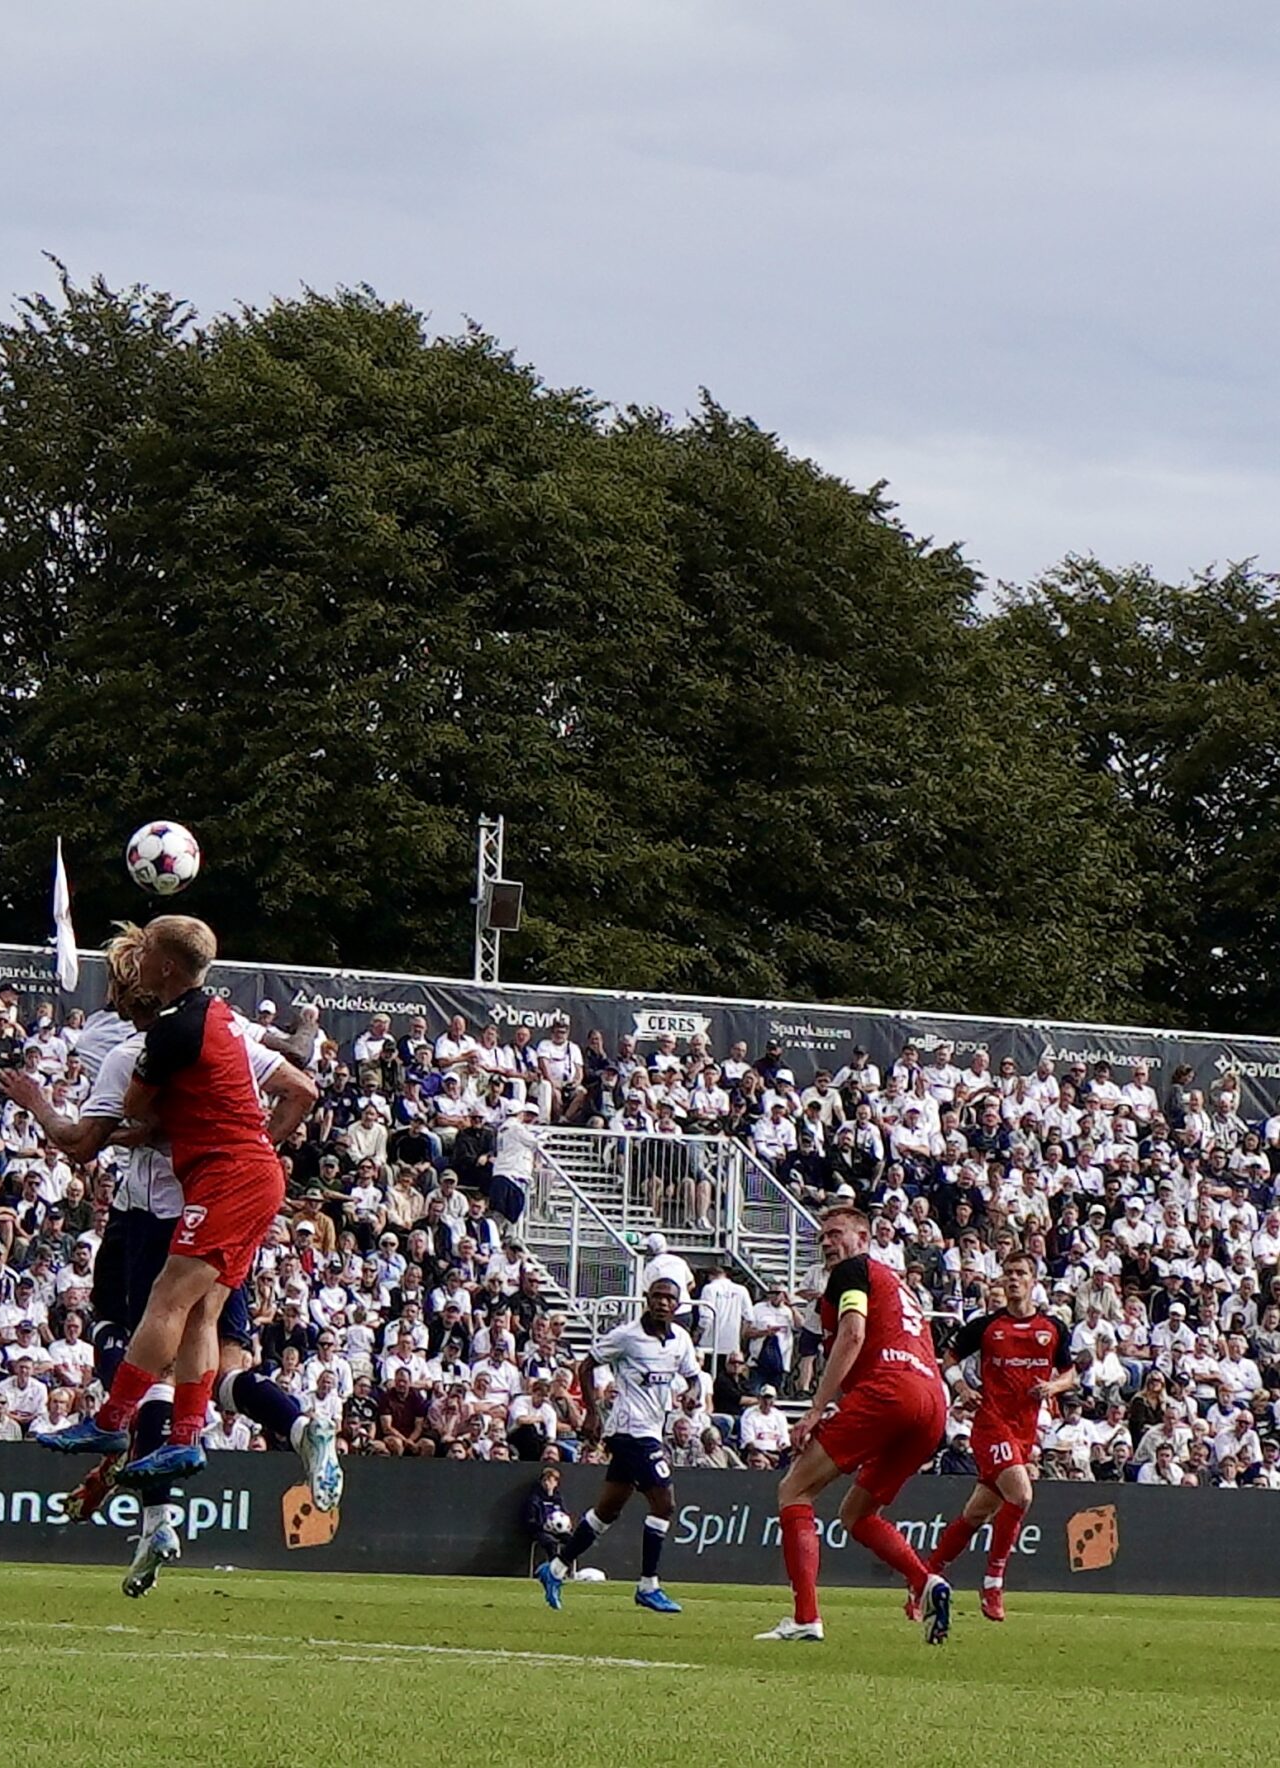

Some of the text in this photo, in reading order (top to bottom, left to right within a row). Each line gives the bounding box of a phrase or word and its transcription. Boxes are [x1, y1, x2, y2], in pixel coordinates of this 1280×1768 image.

[314, 994, 427, 1016] Andelskassen
[507, 1005, 570, 1028] bravida
[647, 1016, 696, 1033] CERES
[770, 1020, 852, 1039] Sparekassen
[1057, 1048, 1162, 1069] Andelskassen
[1232, 1055, 1280, 1079] bravid
[989, 1441, 1014, 1465] 20
[674, 1504, 750, 1555] Spil
